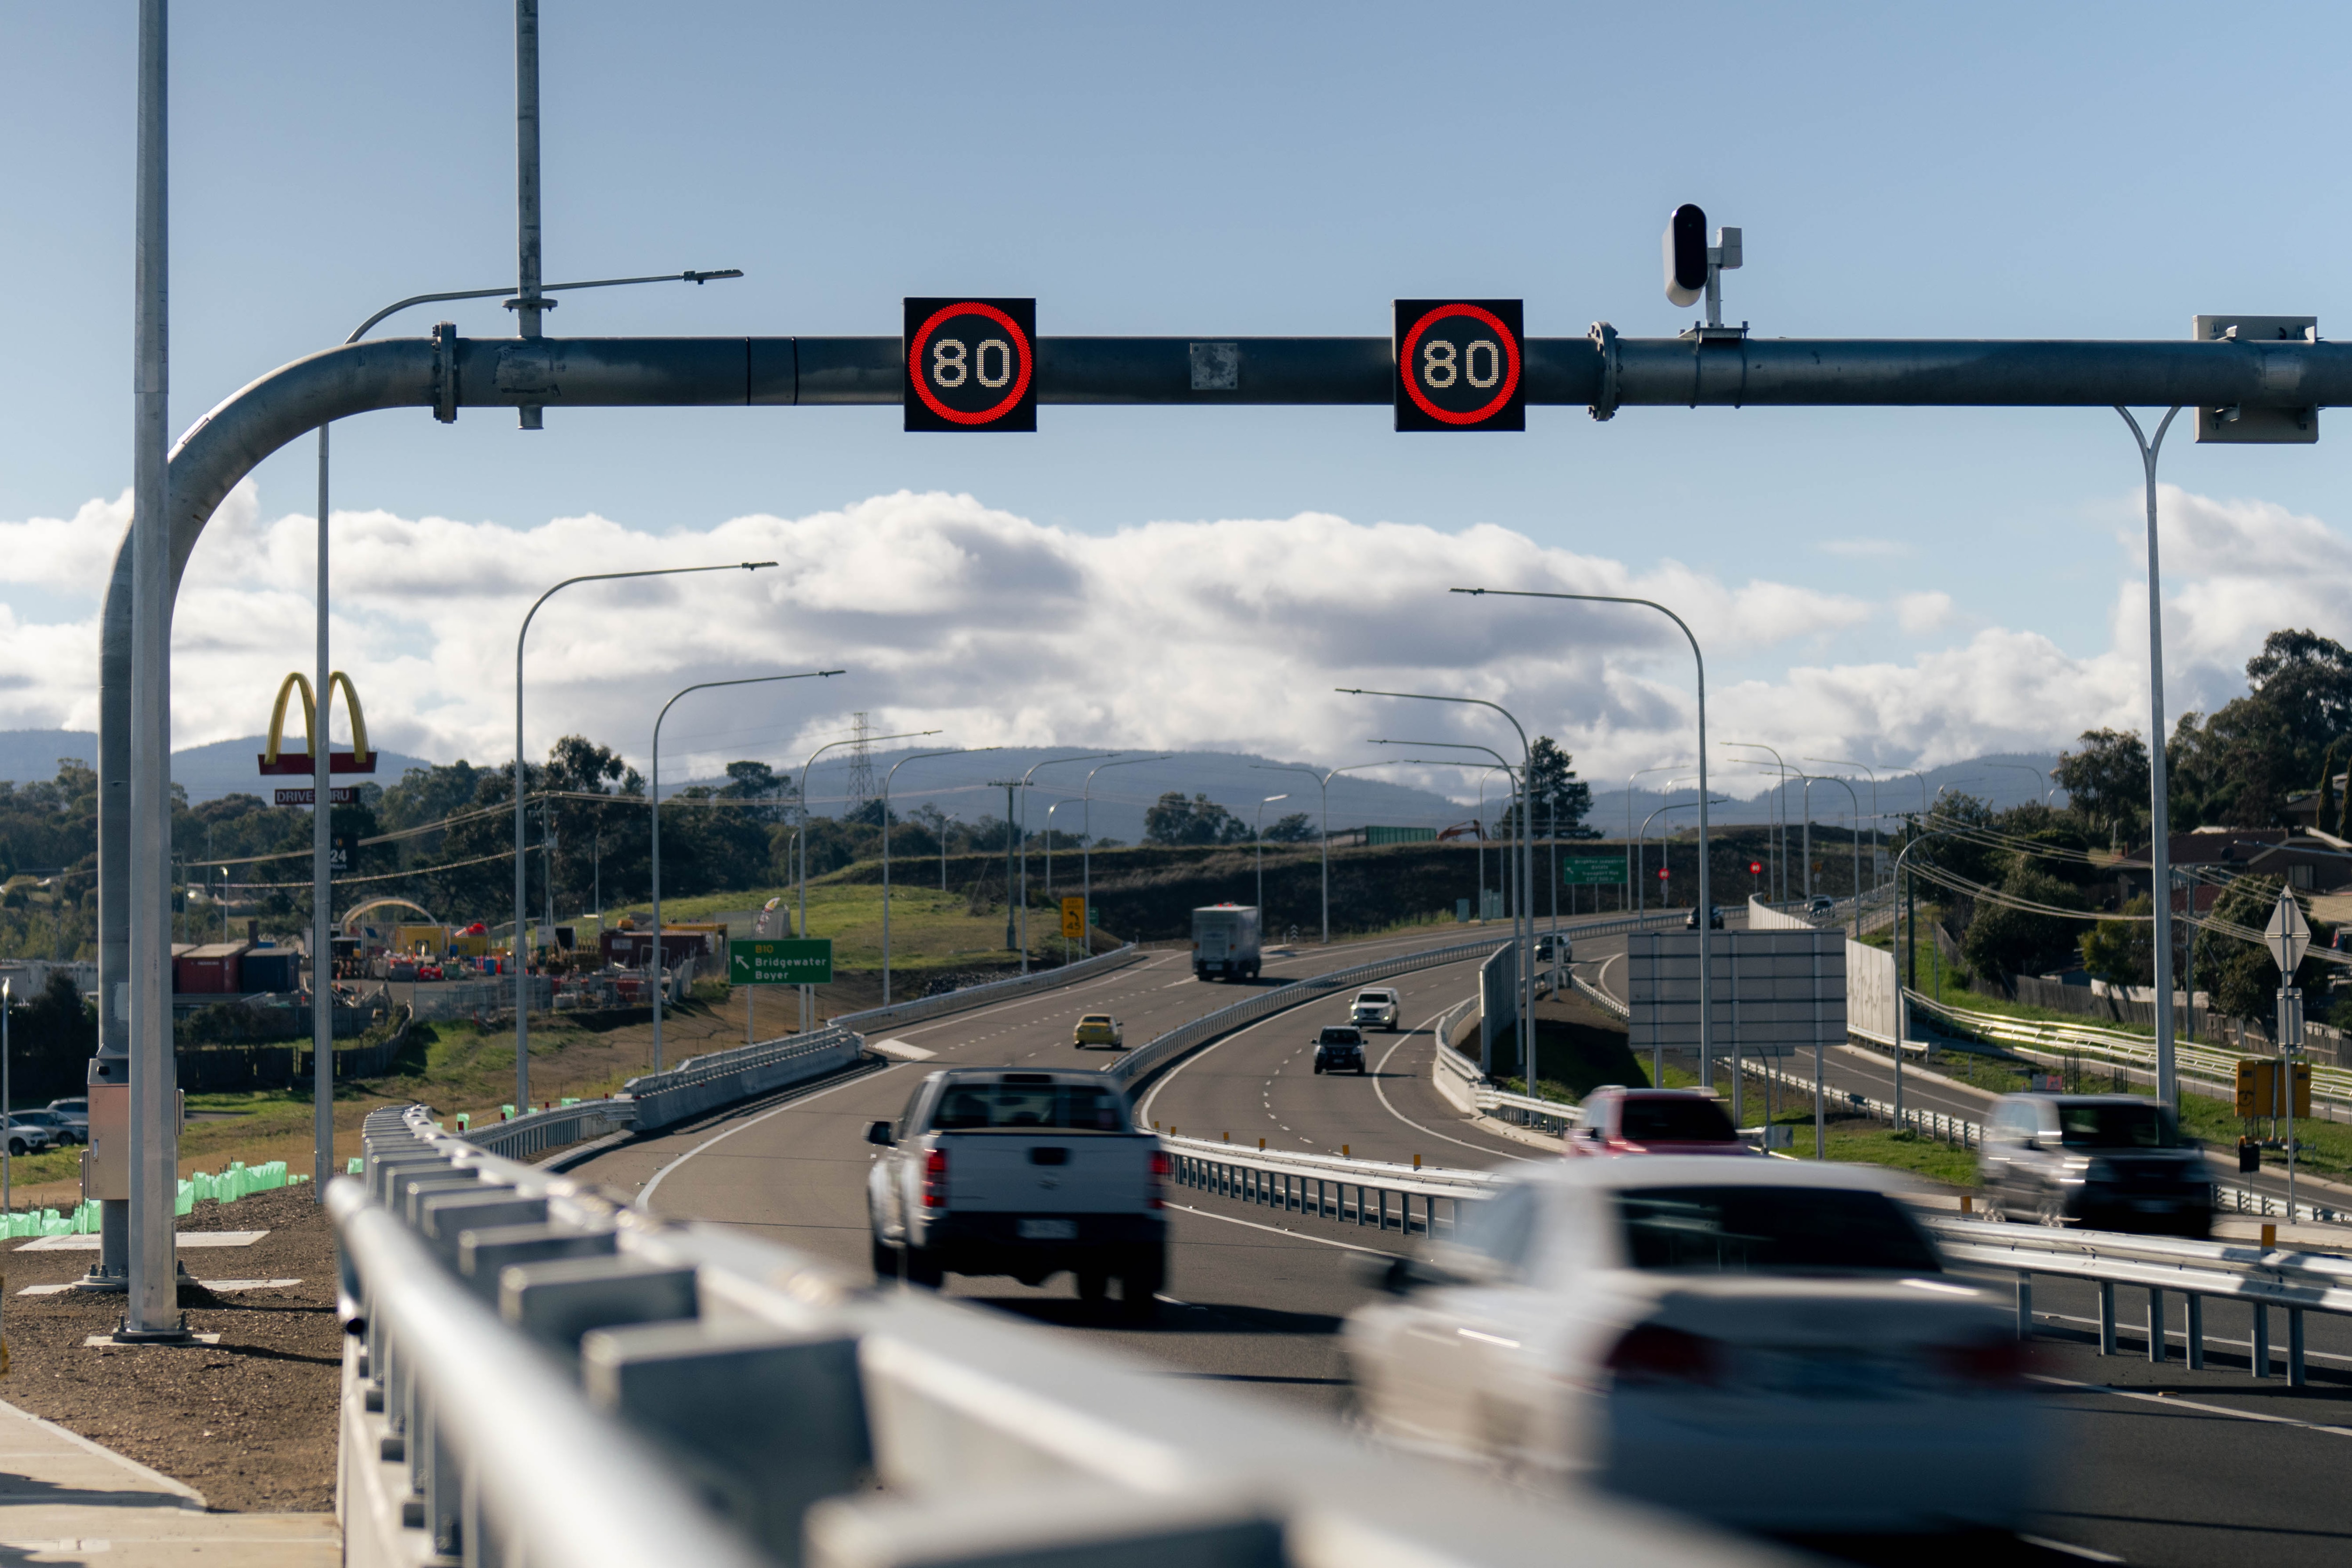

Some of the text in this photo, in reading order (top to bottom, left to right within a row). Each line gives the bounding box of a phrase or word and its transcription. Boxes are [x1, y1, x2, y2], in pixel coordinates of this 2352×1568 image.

[934, 339, 1010, 387] 80
[1424, 340, 1499, 388] 80
[330, 849, 347, 862] 24
[755, 945, 774, 953] B10
[755, 957, 826, 969] Bridgewater
[755, 971, 789, 981] Boyer
